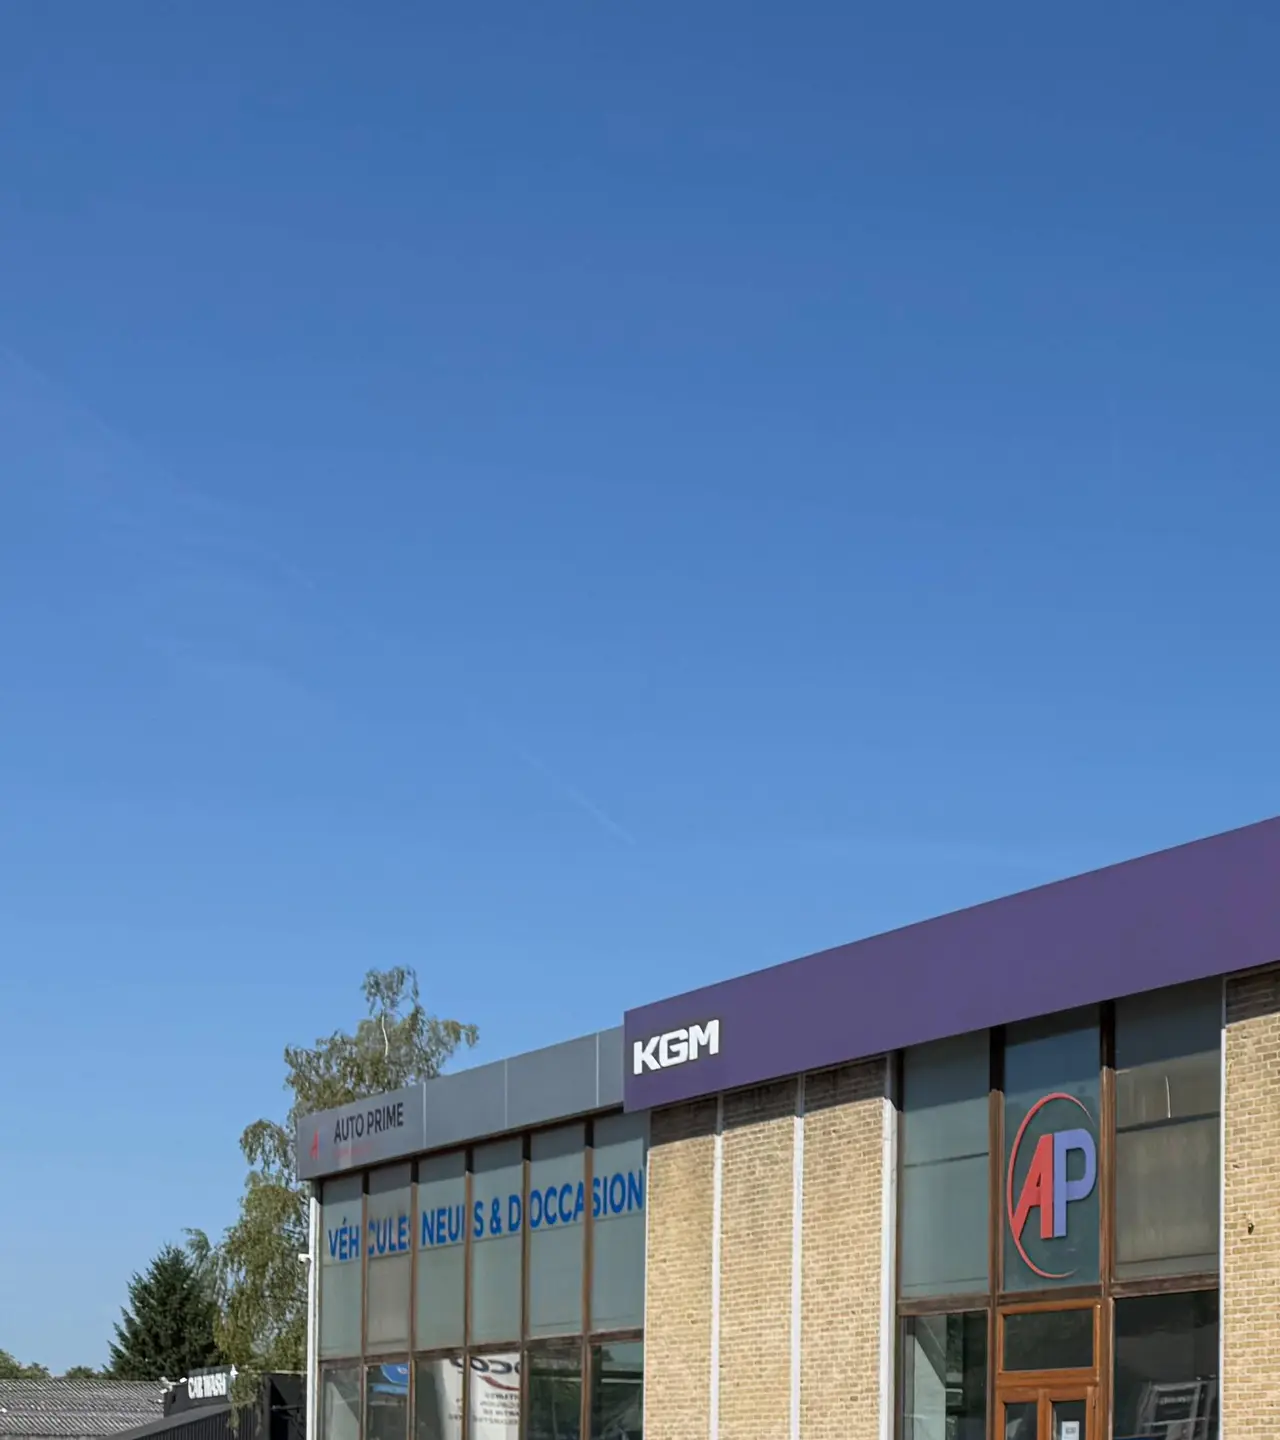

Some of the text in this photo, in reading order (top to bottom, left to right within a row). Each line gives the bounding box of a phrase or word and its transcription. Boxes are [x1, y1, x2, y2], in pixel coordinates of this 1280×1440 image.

[633, 1019, 719, 1075] KGM
[334, 1113, 364, 1144] AUTO
[367, 1102, 404, 1136] PRIME
[1011, 1128, 1097, 1240] AP
[422, 1200, 484, 1246] NEUS
[489, 1197, 502, 1235] &
